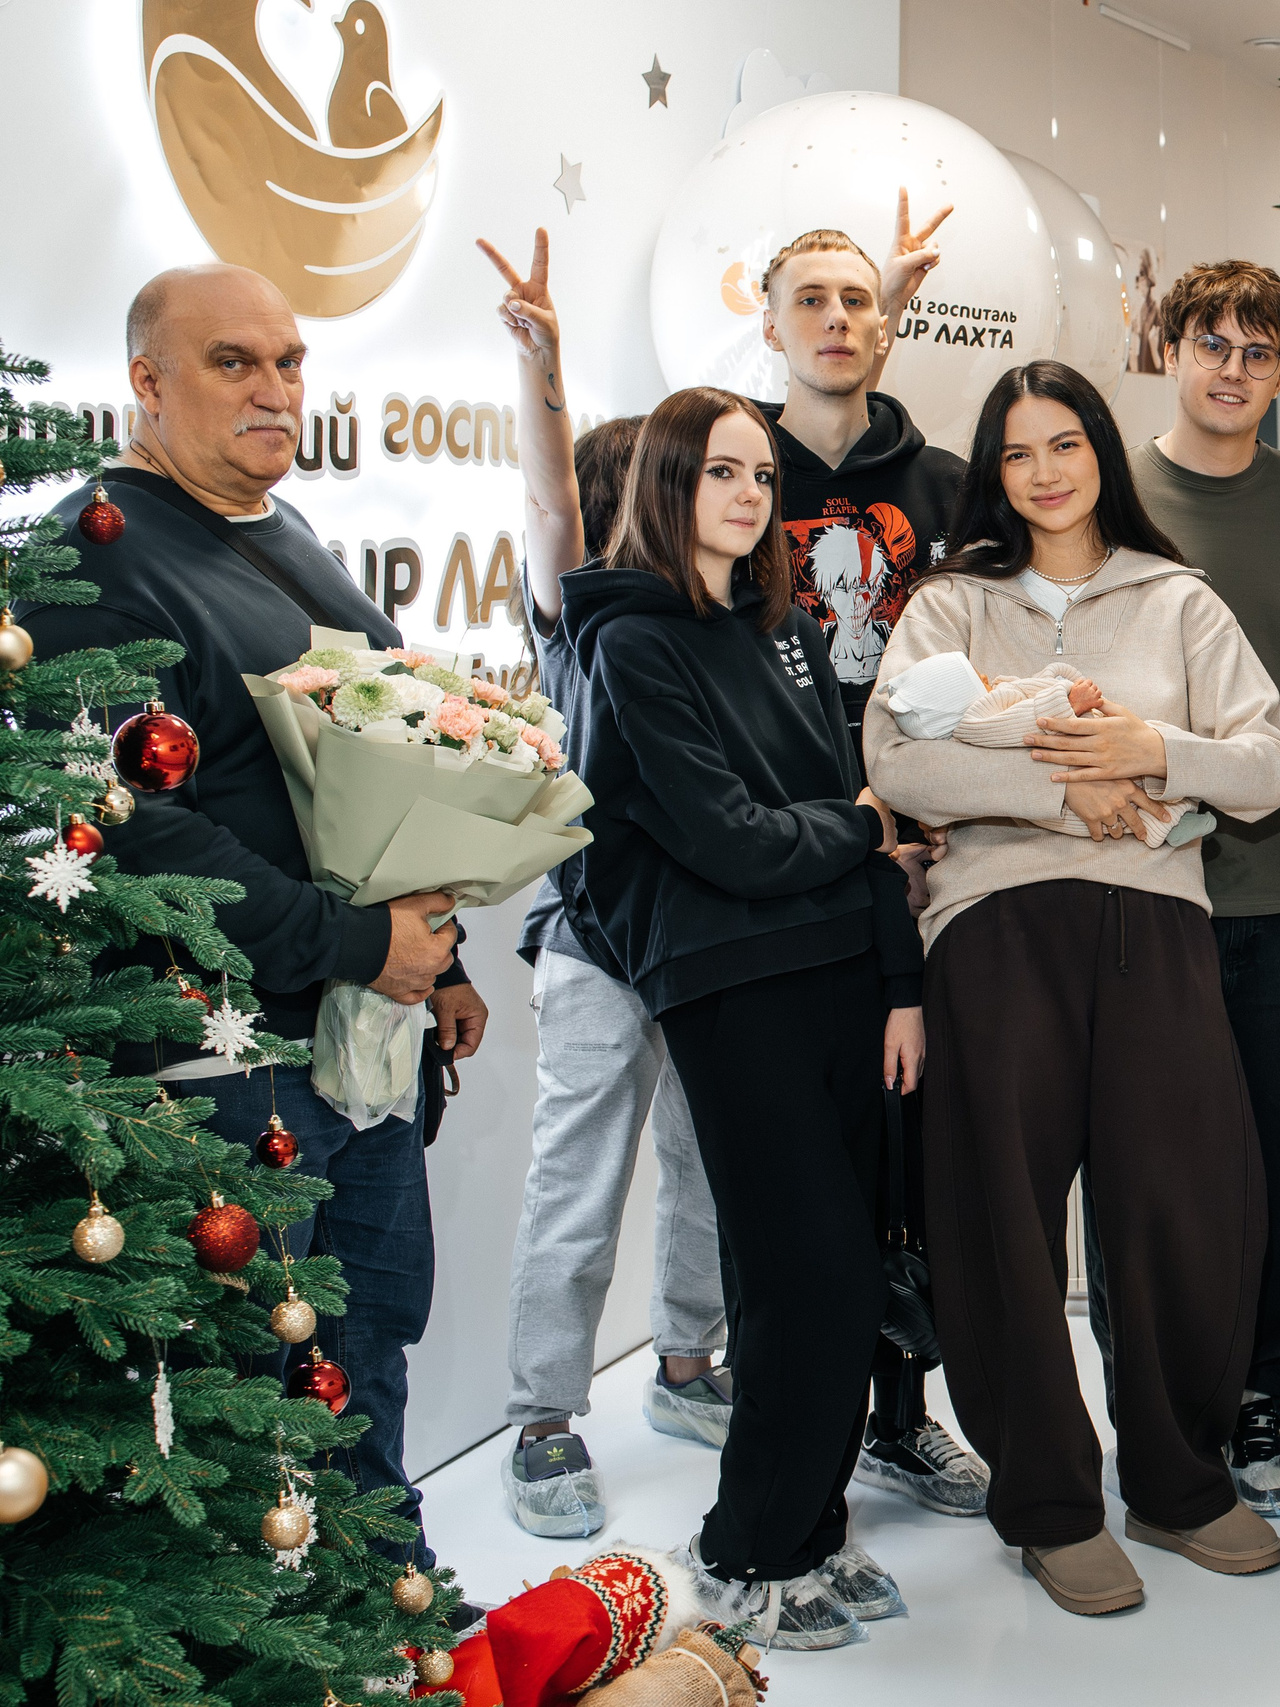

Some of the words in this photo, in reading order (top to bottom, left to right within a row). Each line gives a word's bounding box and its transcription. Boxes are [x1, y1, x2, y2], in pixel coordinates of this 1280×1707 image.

[926, 300, 1018, 324] госпиталь
[933, 322, 1014, 350] ЛАХТА
[825, 497, 852, 507] SOUL
[821, 505, 860, 516] REAPER
[790, 635, 800, 645] IS
[790, 648, 804, 660] NE
[795, 661, 809, 673] BA
